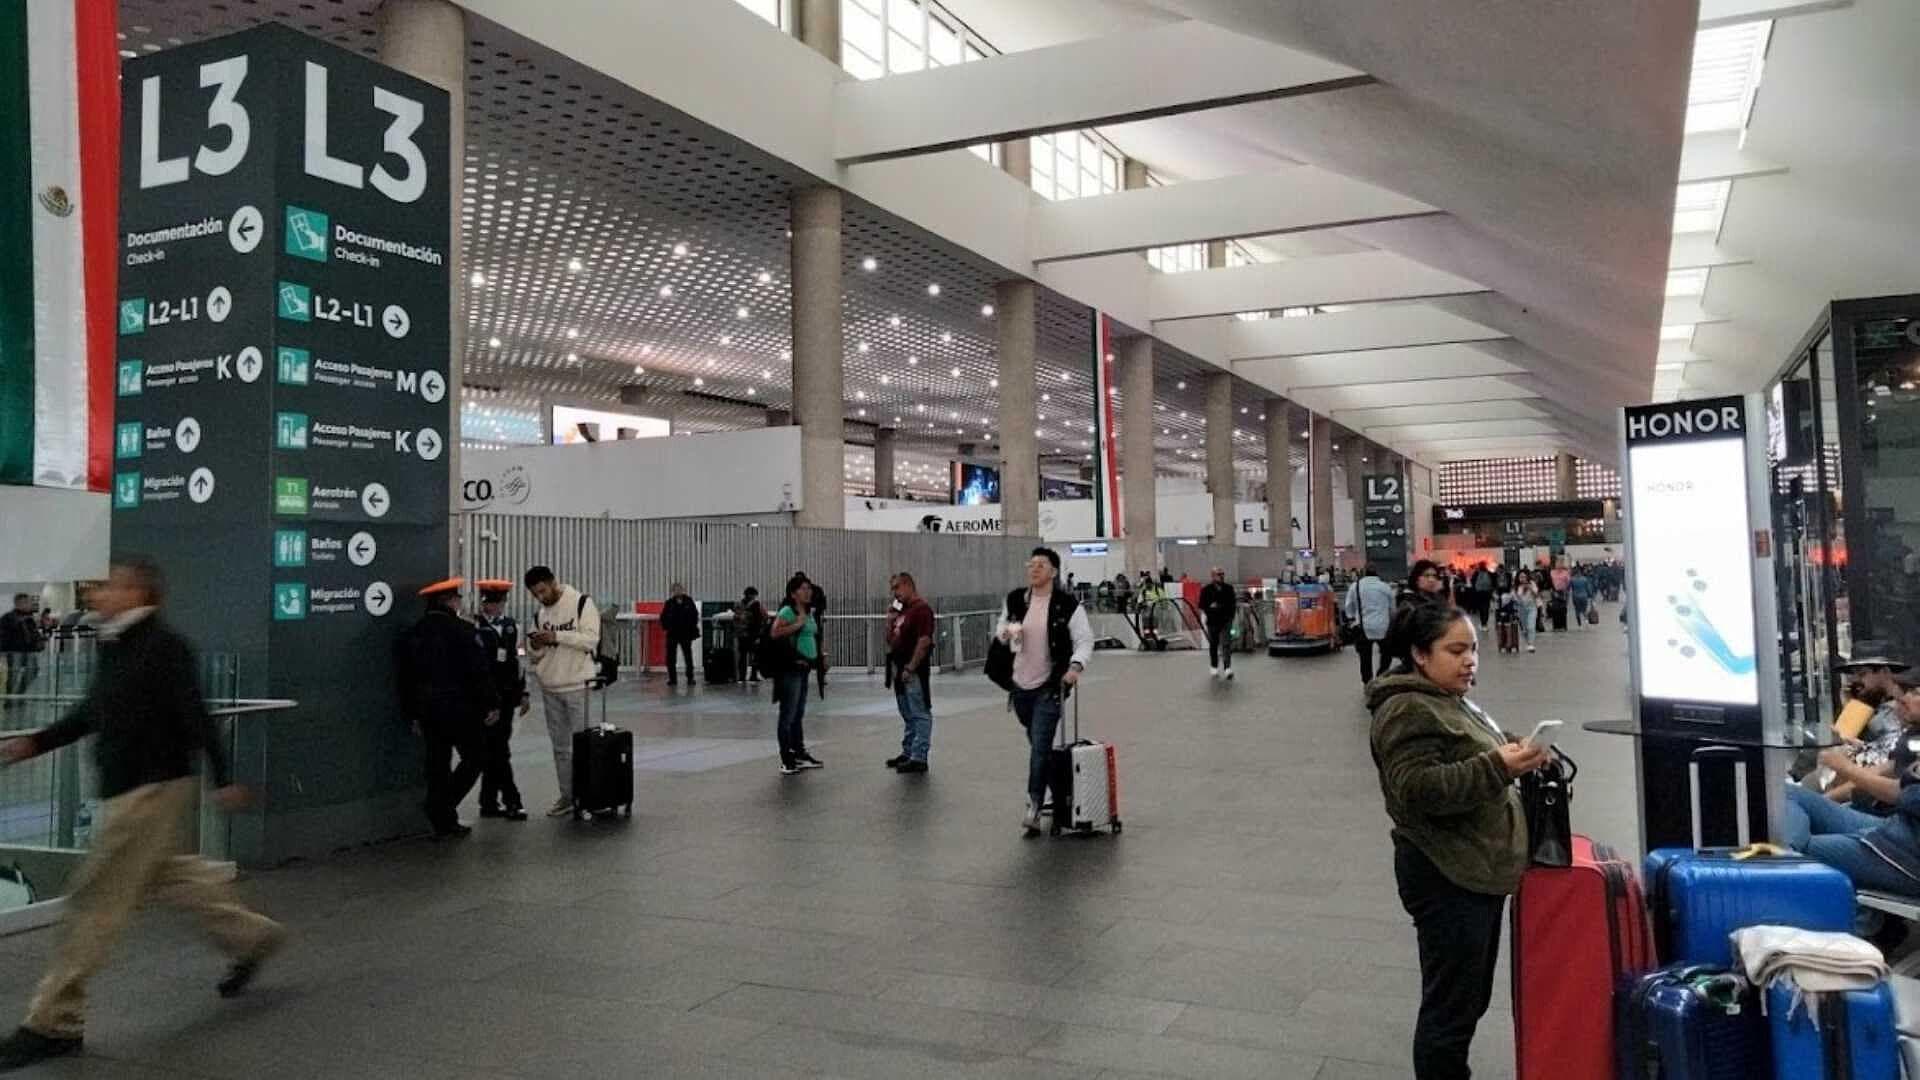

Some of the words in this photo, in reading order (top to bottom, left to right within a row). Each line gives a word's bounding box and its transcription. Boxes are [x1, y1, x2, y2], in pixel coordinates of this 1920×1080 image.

[140, 54, 250, 189] L3
[305, 61, 427, 203] L3
[127, 217, 223, 247] Documentación
[335, 225, 442, 265] Documentación
[127, 250, 165, 265] Check-in
[335, 247, 380, 268] Check-in
[149, 297, 198, 326] L2-L1
[315, 296, 373, 327] L2-L1
[217, 354, 232, 380] K
[314, 358, 350, 373] Acceso
[351, 363, 394, 379] Pasajeros
[396, 369, 416, 394] M
[1629, 406, 1740, 439] HONOR
[312, 422, 348, 435] Acceso
[348, 424, 392, 440] Pasajeros
[395, 429, 411, 453] K
[1368, 477, 1399, 500] L2
[1648, 481, 1695, 493] HONOR
[1506, 521, 1520, 533] L1
[311, 537, 343, 549] Baños
[311, 587, 360, 602] Migración
